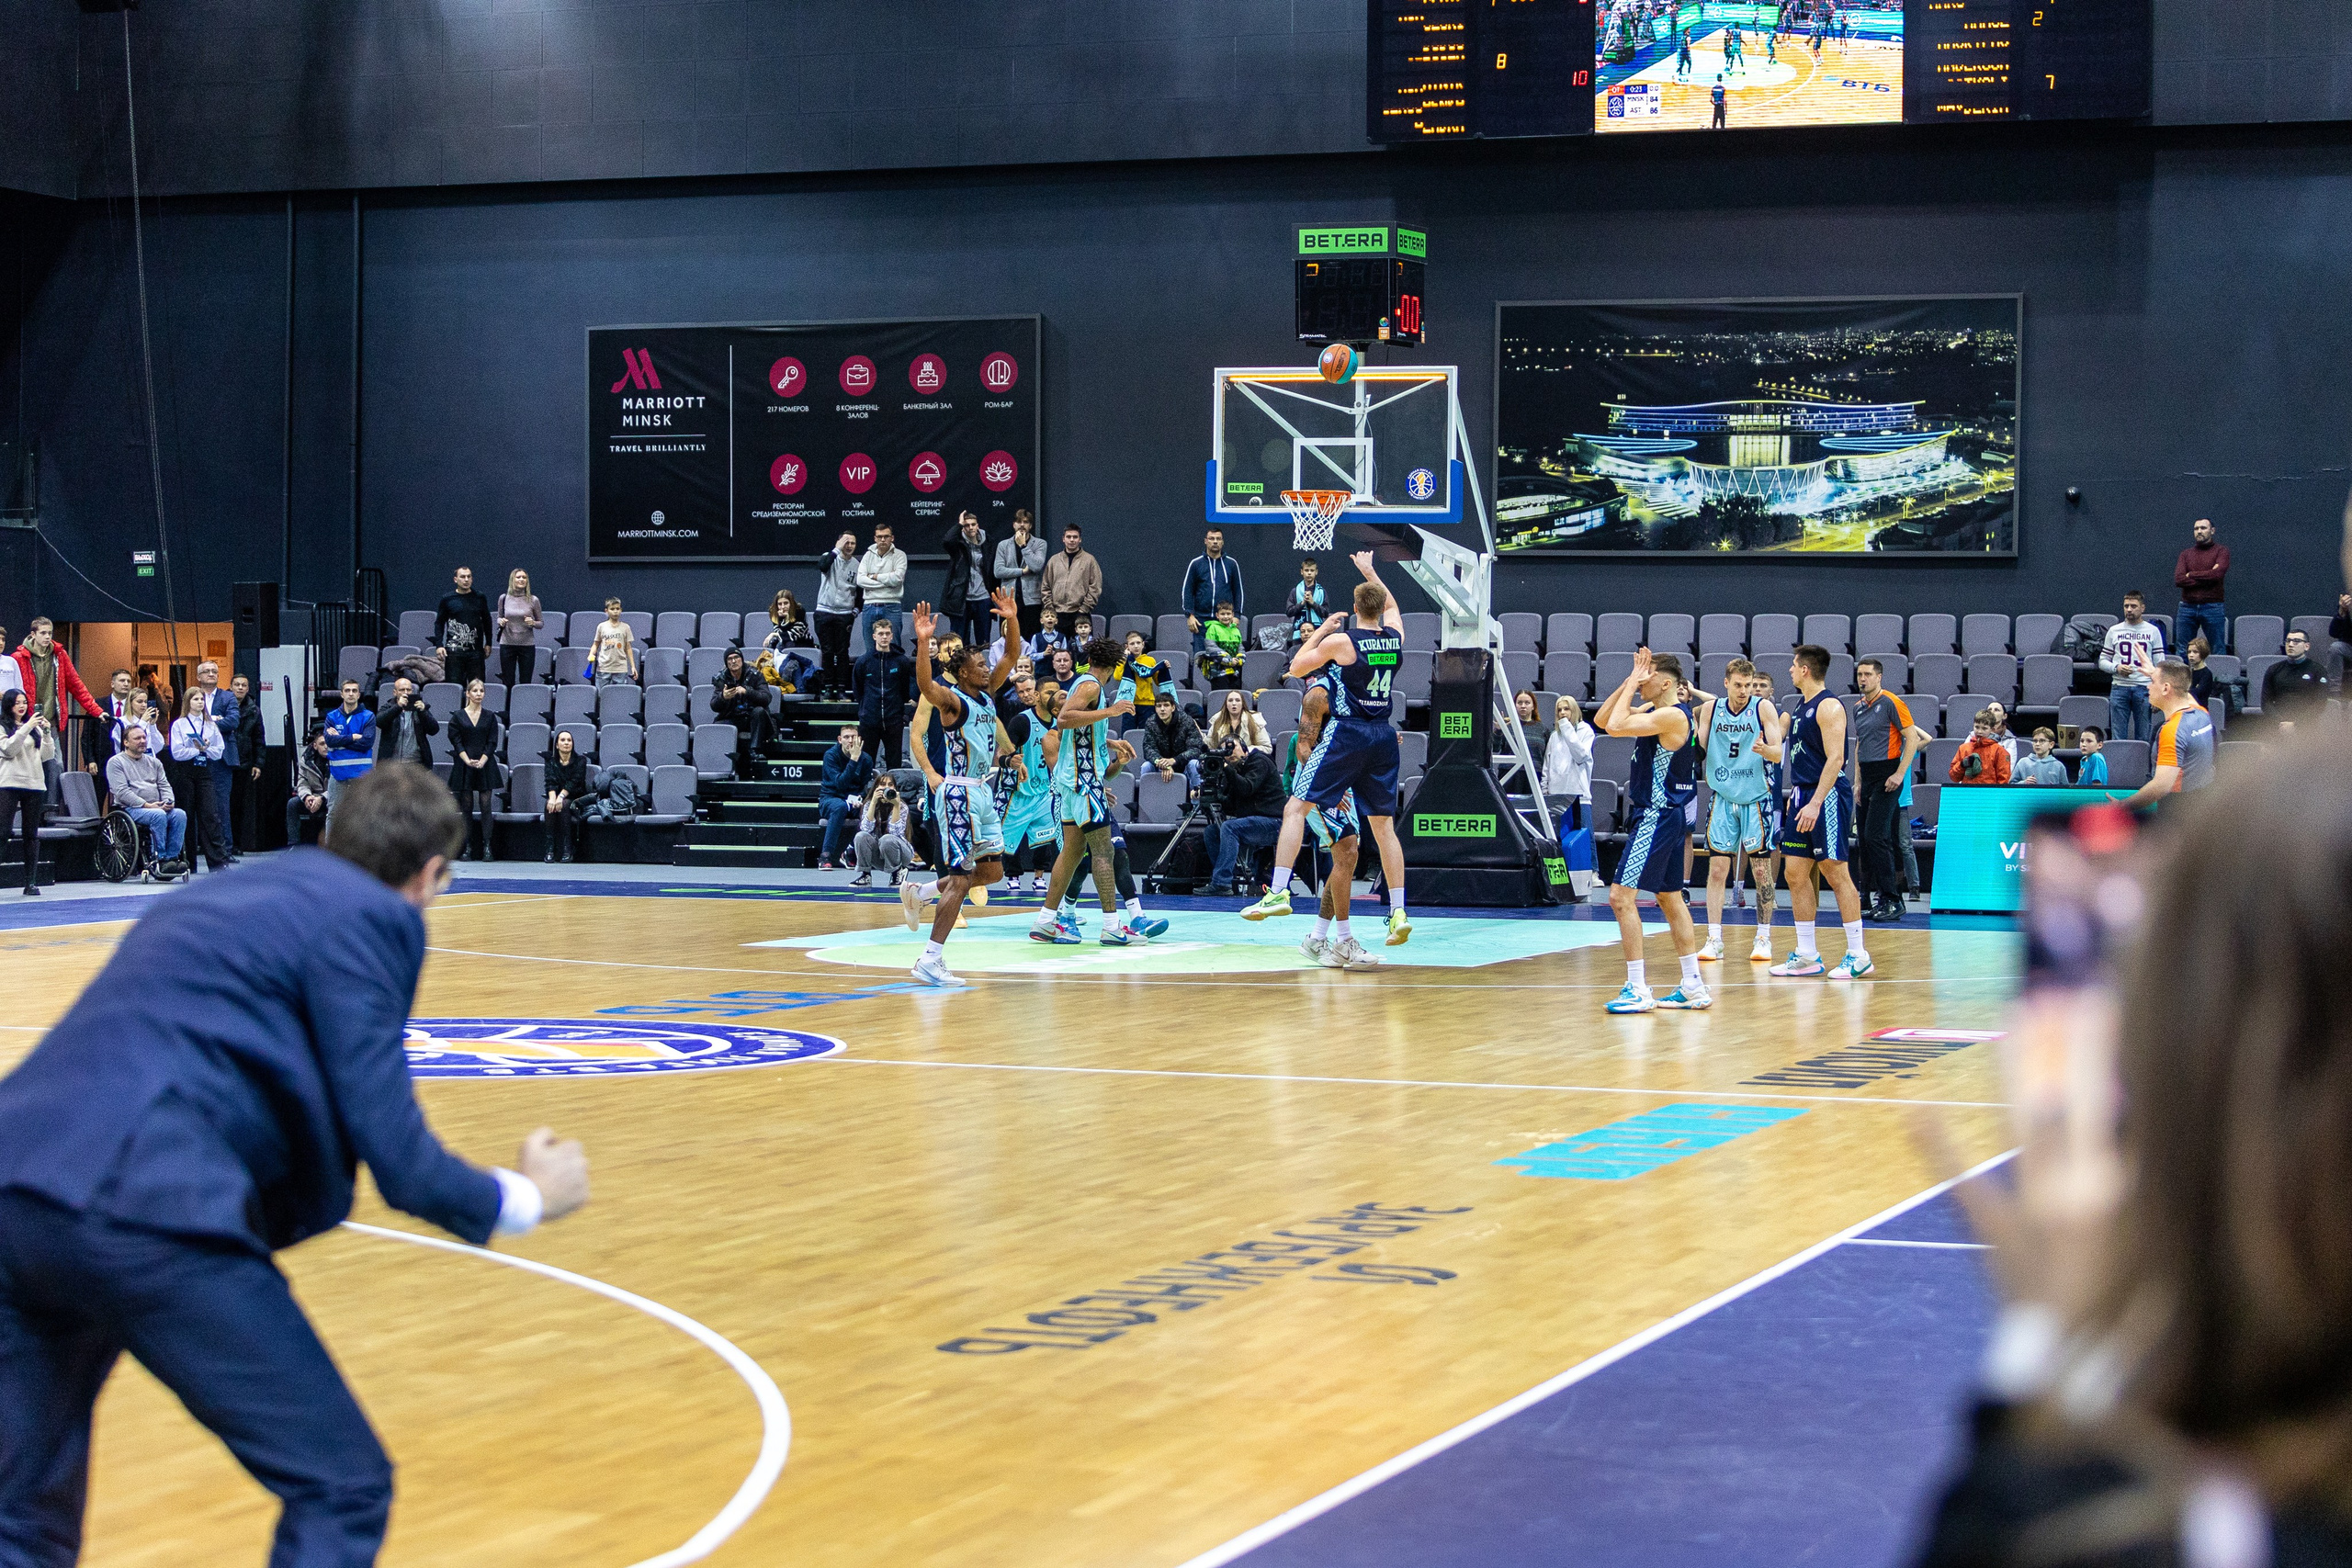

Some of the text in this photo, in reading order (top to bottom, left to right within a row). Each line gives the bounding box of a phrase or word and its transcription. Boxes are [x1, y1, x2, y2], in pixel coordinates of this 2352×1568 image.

[2032, 10, 2043, 27] 2
[1496, 52, 1507, 70] 8
[1572, 70, 1589, 86] 10
[2045, 74, 2054, 90] 7
[622, 396, 706, 410] MARRIOTT
[622, 414, 673, 426] MINSK
[846, 467, 870, 480] VIP
[752, 509, 826, 518] СРЕДИЗЕМНОМОРСКОЙ
[617, 529, 699, 538] MARRIOTTMINSK.COM
[2117, 632, 2152, 641] MICHIGAN
[1358, 637, 1401, 652] KURATNIK
[1366, 669, 1392, 698] 44
[1444, 716, 1469, 725] BET
[1715, 722, 1754, 734] ASTANA
[987, 734, 994, 752] 2
[1728, 742, 1740, 759] 5
[783, 766, 803, 778] 105
[935, 1201, 1474, 1356] ЗАРУБЕЖНЕФТЬ
